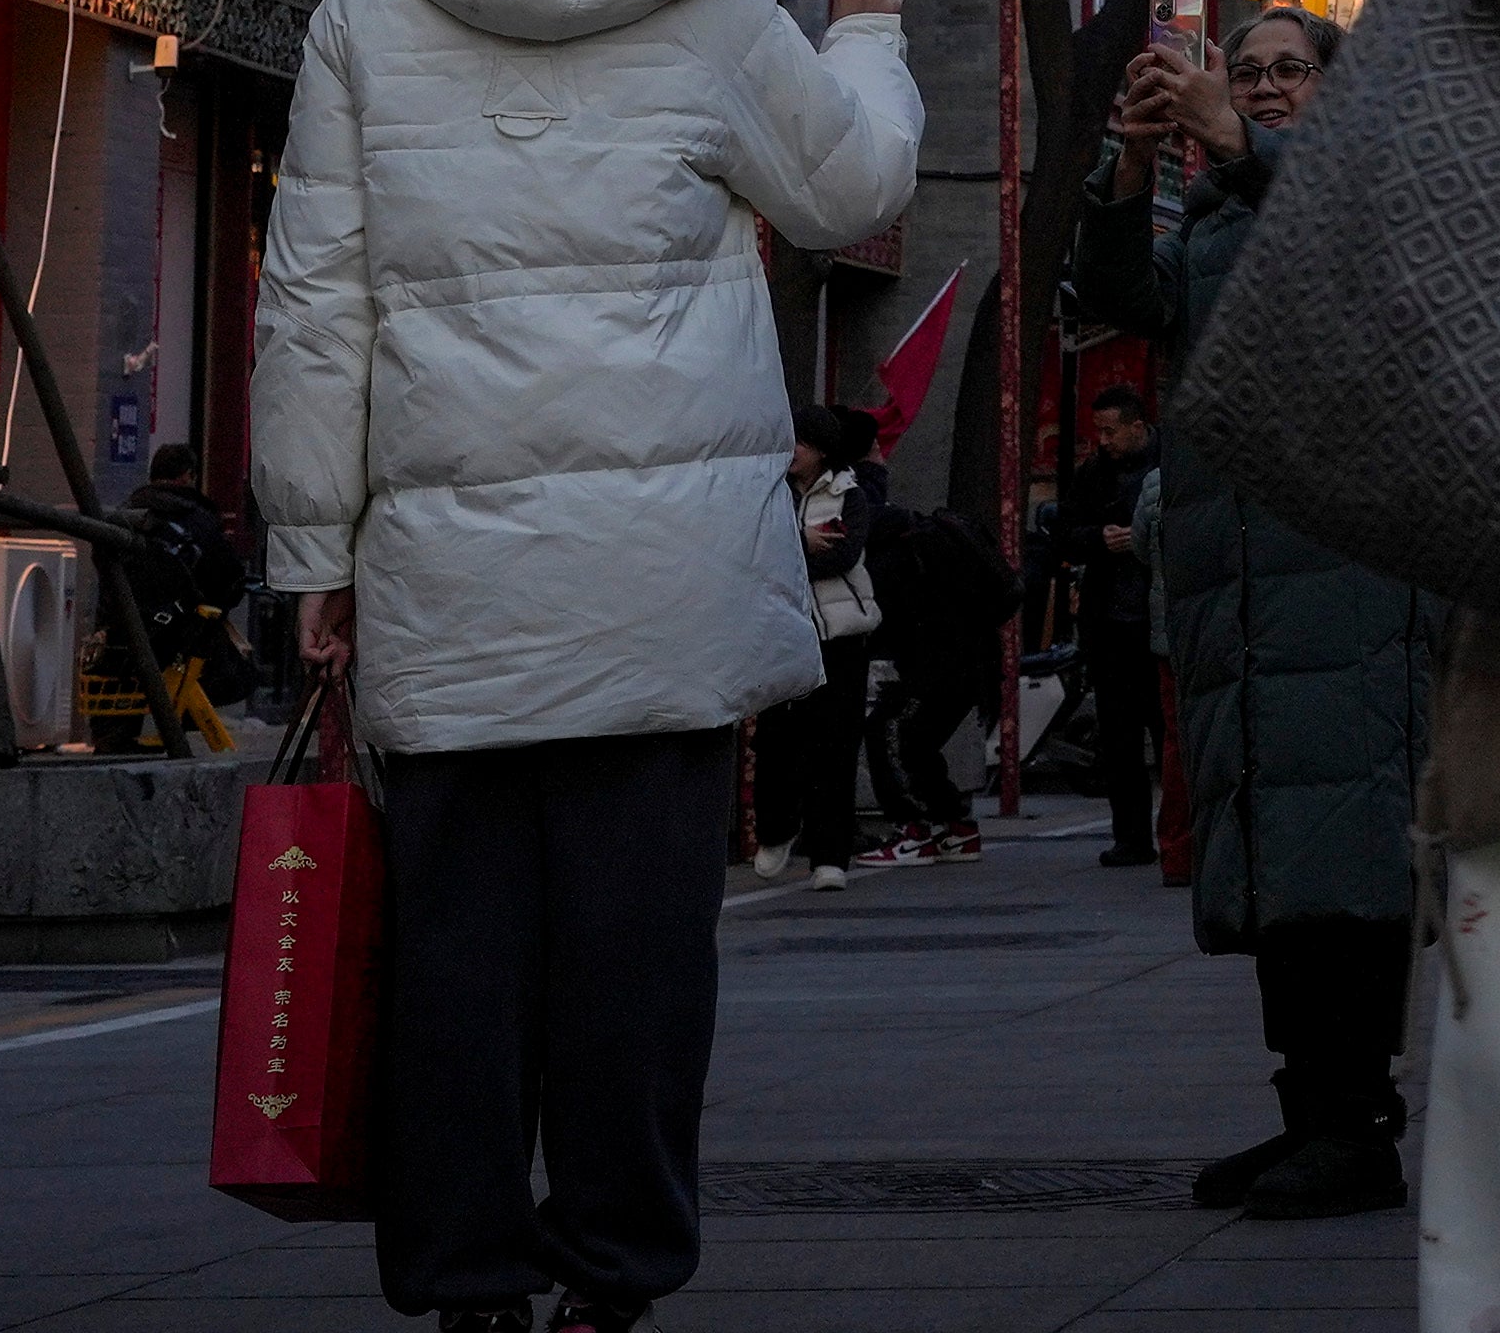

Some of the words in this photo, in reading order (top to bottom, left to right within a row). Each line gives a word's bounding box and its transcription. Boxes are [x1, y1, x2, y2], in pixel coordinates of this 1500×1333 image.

[276, 890, 299, 973] 以文会友
[267, 989, 292, 1073] 荣名为宝
